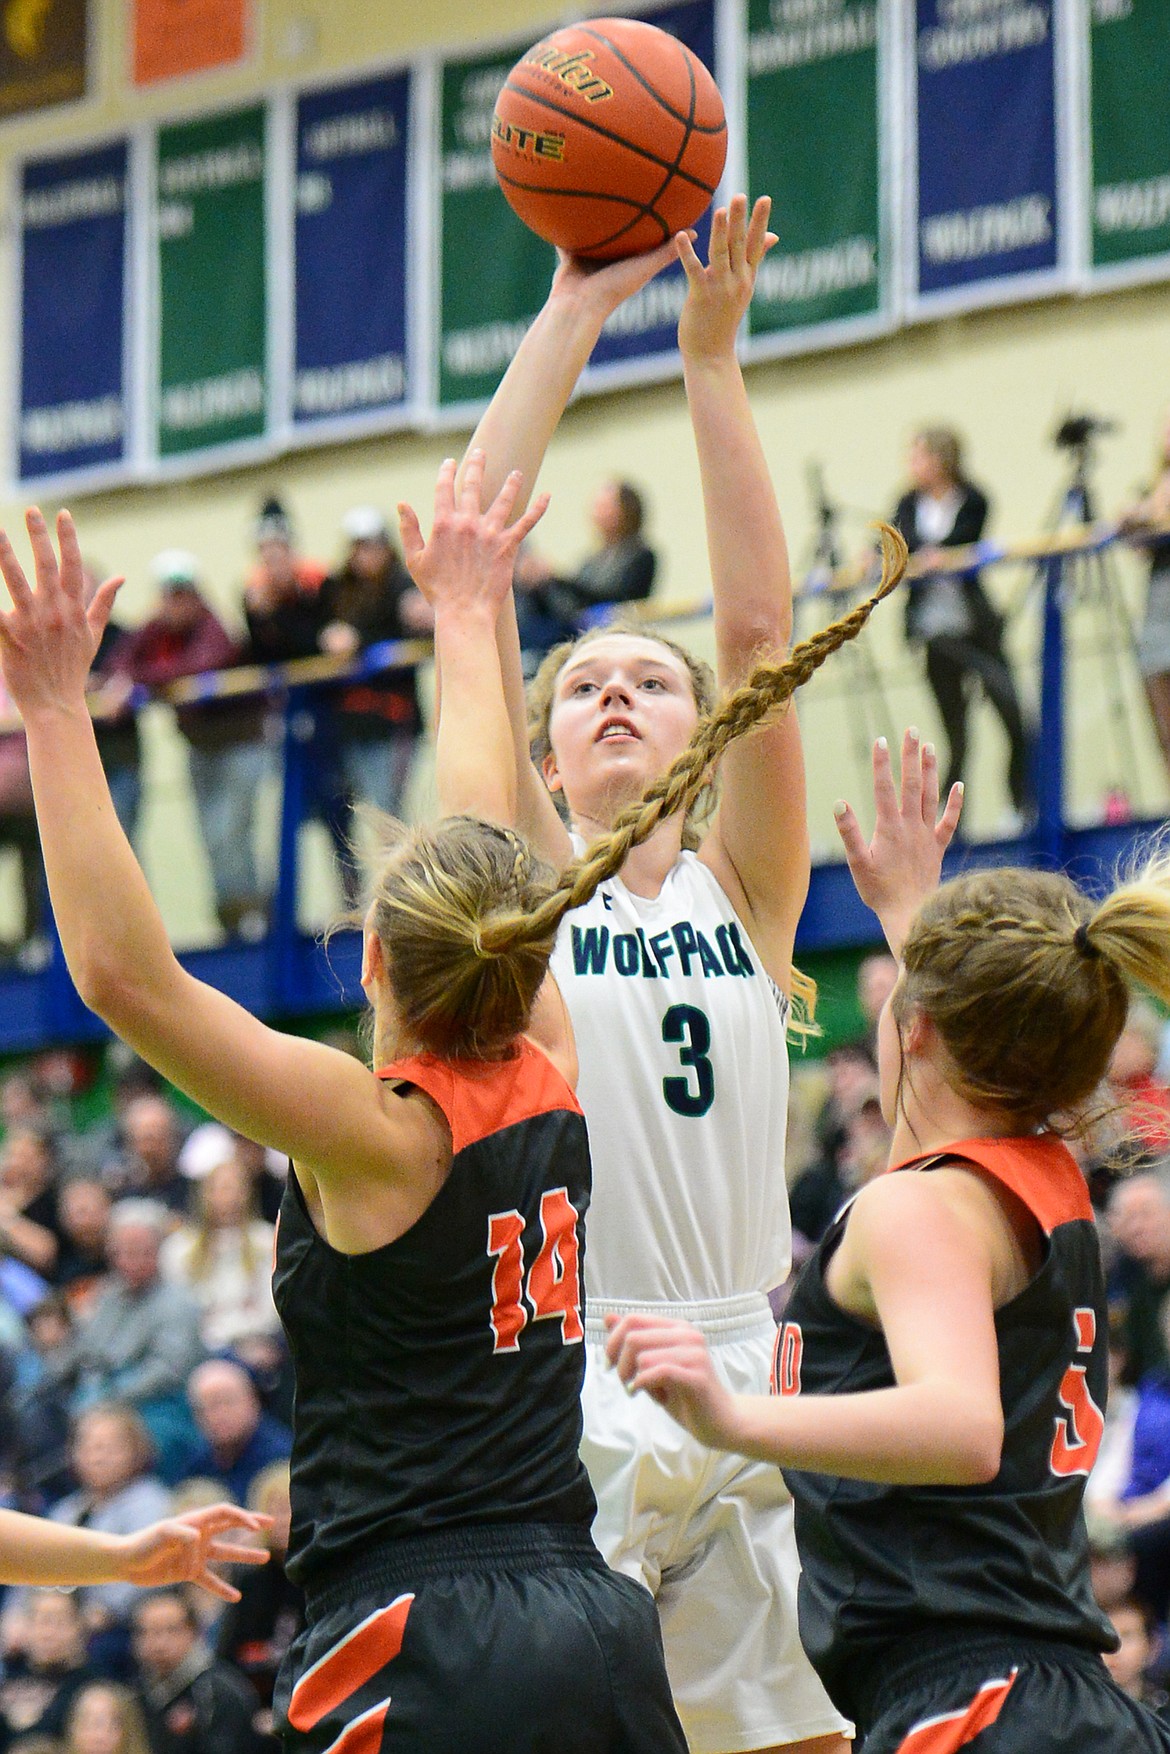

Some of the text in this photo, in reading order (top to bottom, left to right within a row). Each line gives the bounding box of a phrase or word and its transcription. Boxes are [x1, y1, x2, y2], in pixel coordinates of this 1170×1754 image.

[491, 117, 566, 164] LITE
[661, 1003, 715, 1118] 3
[487, 1186, 585, 1354] 14
